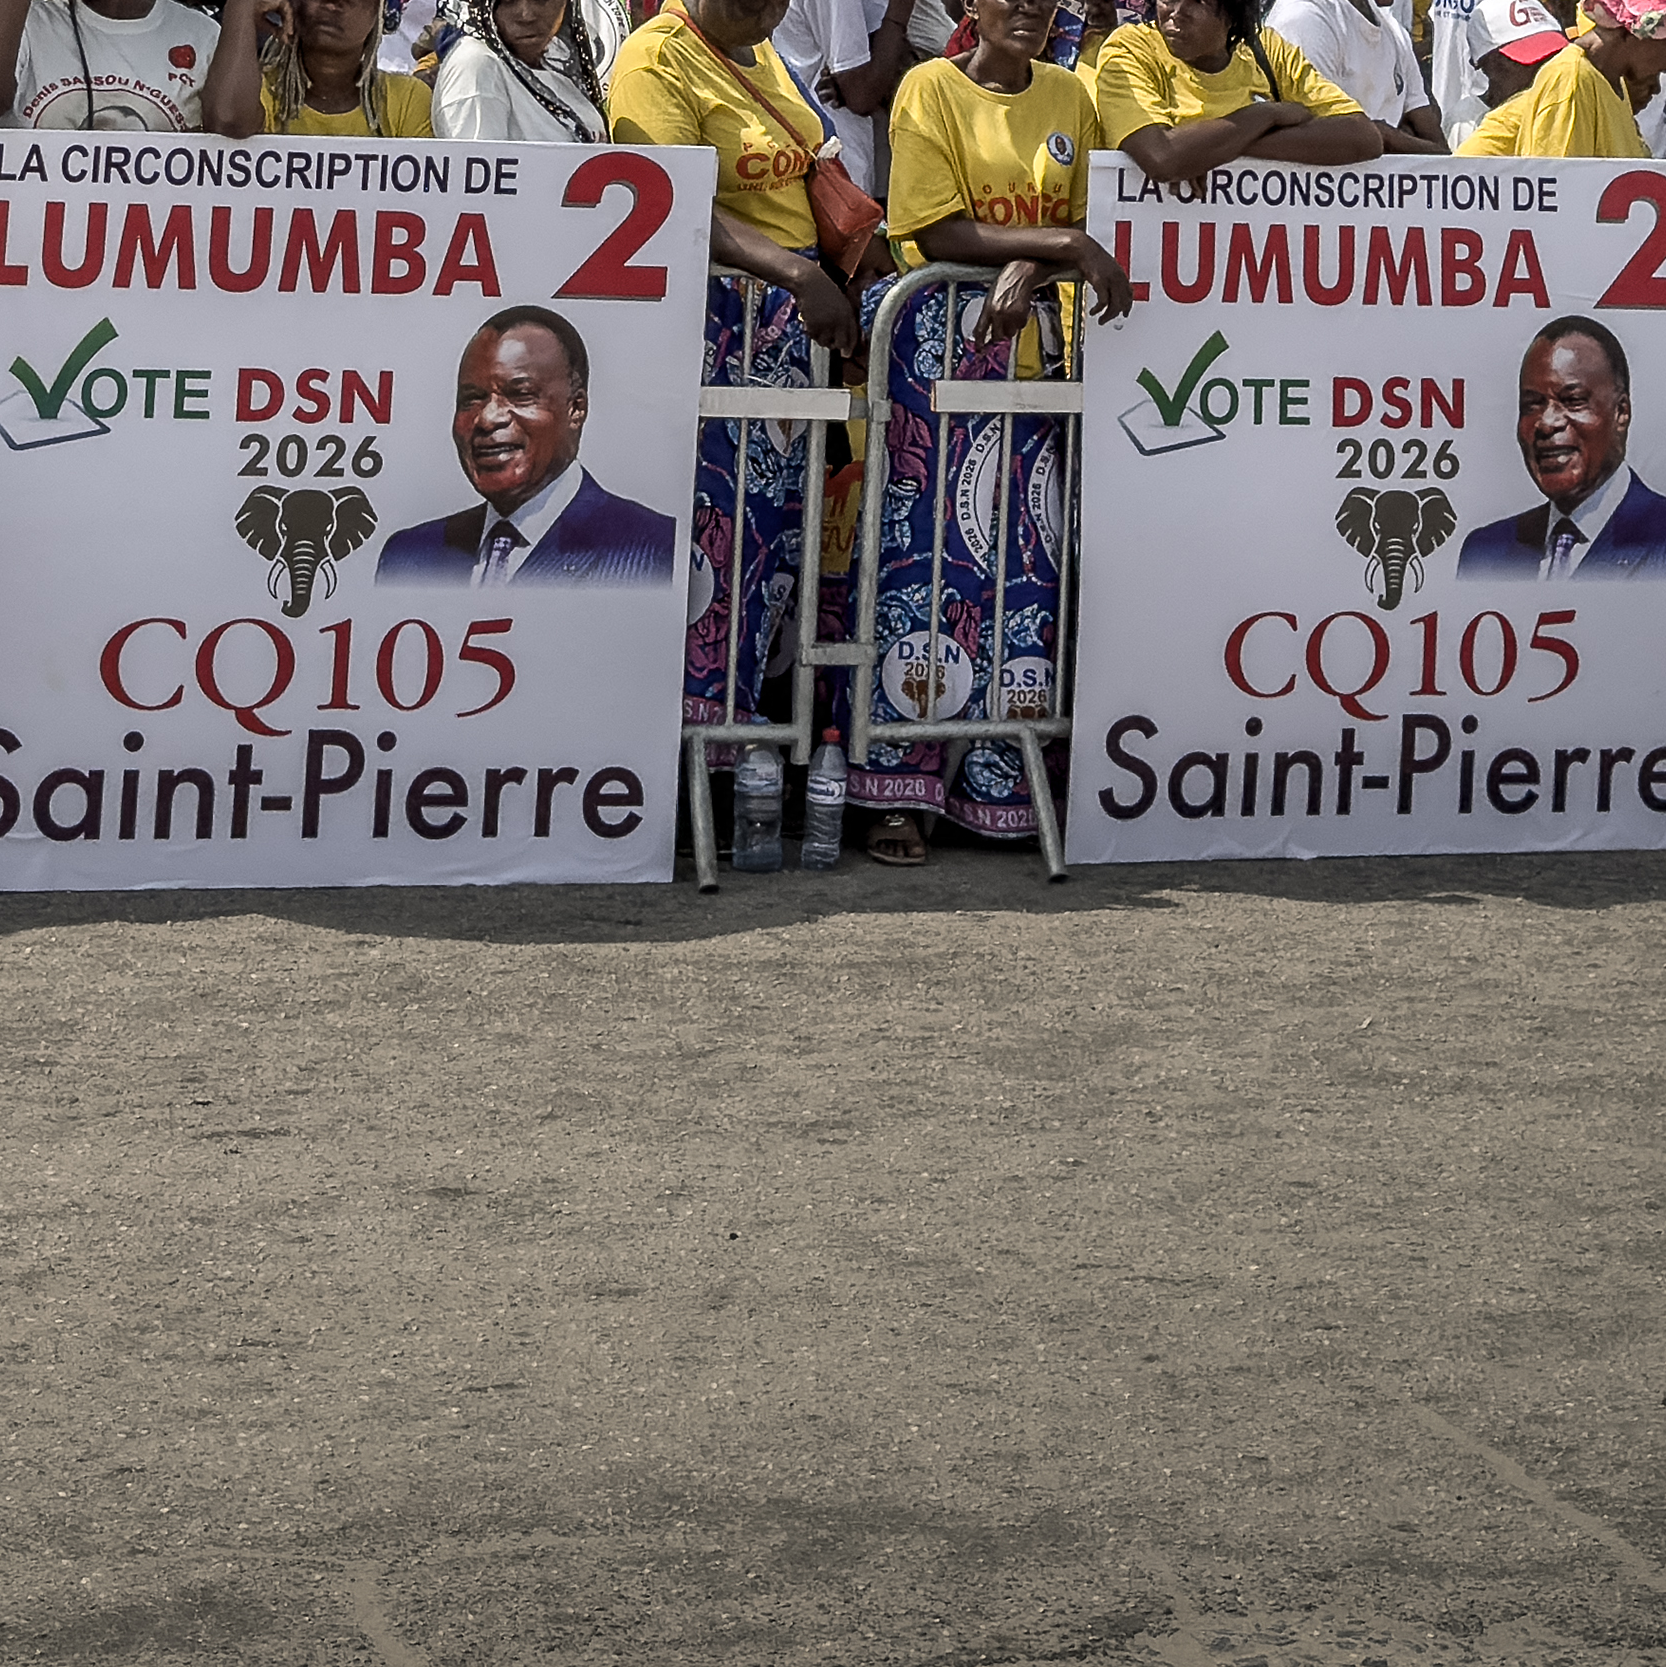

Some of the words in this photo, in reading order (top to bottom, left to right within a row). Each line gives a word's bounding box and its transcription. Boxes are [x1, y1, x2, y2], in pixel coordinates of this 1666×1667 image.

[60, 74, 130, 87] SASOU
[61, 144, 450, 195] CIRCONSCRIPTION
[463, 155, 519, 196] DE
[736, 149, 811, 181] CON
[1116, 167, 1164, 204] LA
[1175, 169, 1501, 212] RCONSCRIPTION
[1512, 176, 1559, 213] DE
[551, 150, 675, 301] 2
[1114, 220, 1551, 310] LUMUMBA
[8, 315, 213, 423] VOTE
[235, 367, 394, 426] DSN
[1136, 329, 1311, 427] VOTE
[1331, 376, 1466, 429] DSN
[236, 432, 384, 480] 2026
[1334, 437, 1461, 481] 2026
[904, 662, 946, 681] 206
